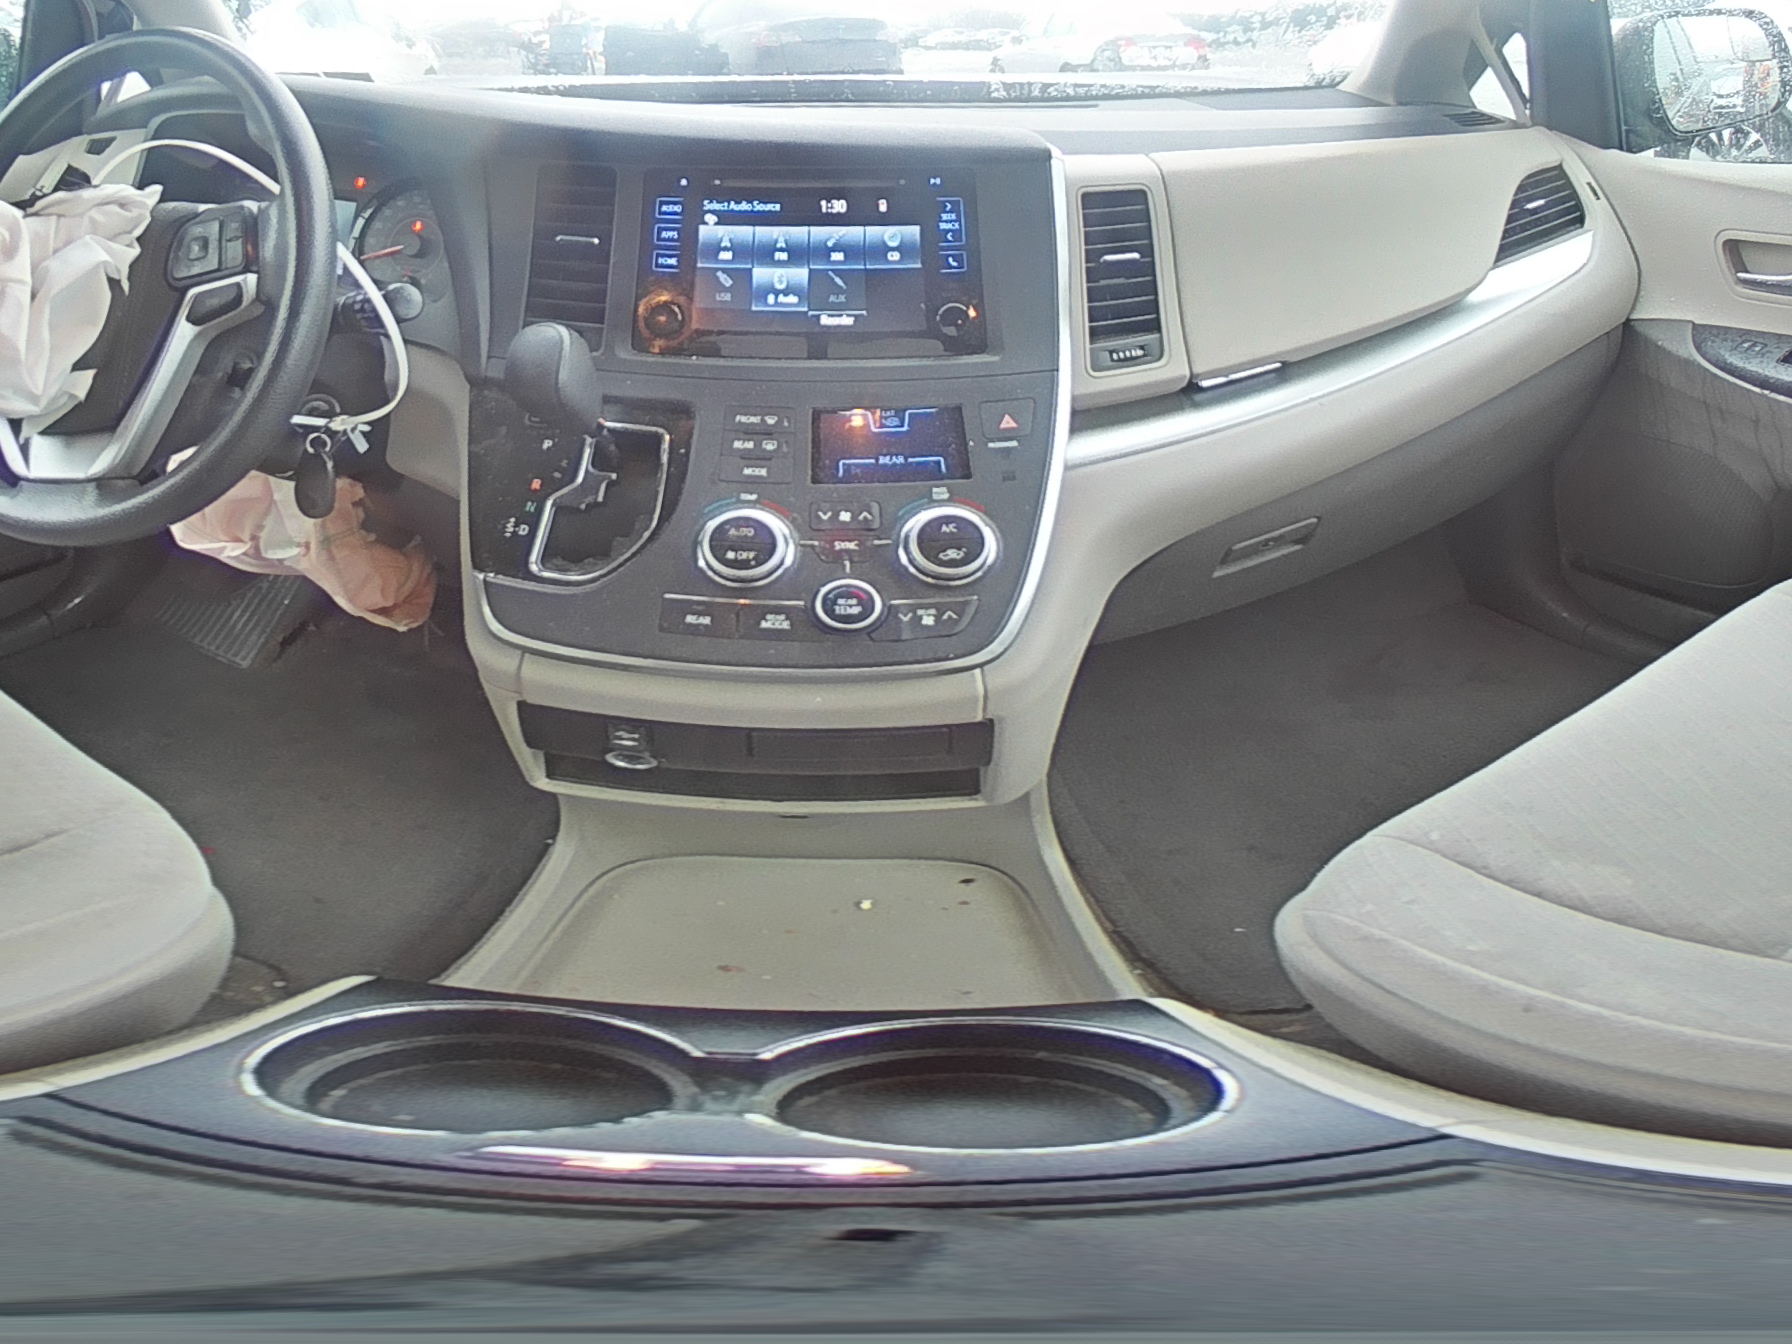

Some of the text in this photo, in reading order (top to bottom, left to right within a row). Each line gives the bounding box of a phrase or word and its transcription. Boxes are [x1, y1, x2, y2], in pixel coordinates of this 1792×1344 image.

[702, 199, 781, 212] Select Audio Source
[819, 199, 847, 213] 1:30
[828, 294, 847, 303] AUX
[819, 314, 855, 326] Reorder
[541, 438, 554, 451] P
[732, 440, 755, 450] REAR
[742, 467, 768, 477] MODE
[530, 478, 542, 490] R
[524, 501, 537, 513] N
[940, 522, 957, 533] A/C
[833, 541, 859, 550] SYNC
[832, 605, 863, 615] TEMP
[684, 614, 712, 626] REAR
